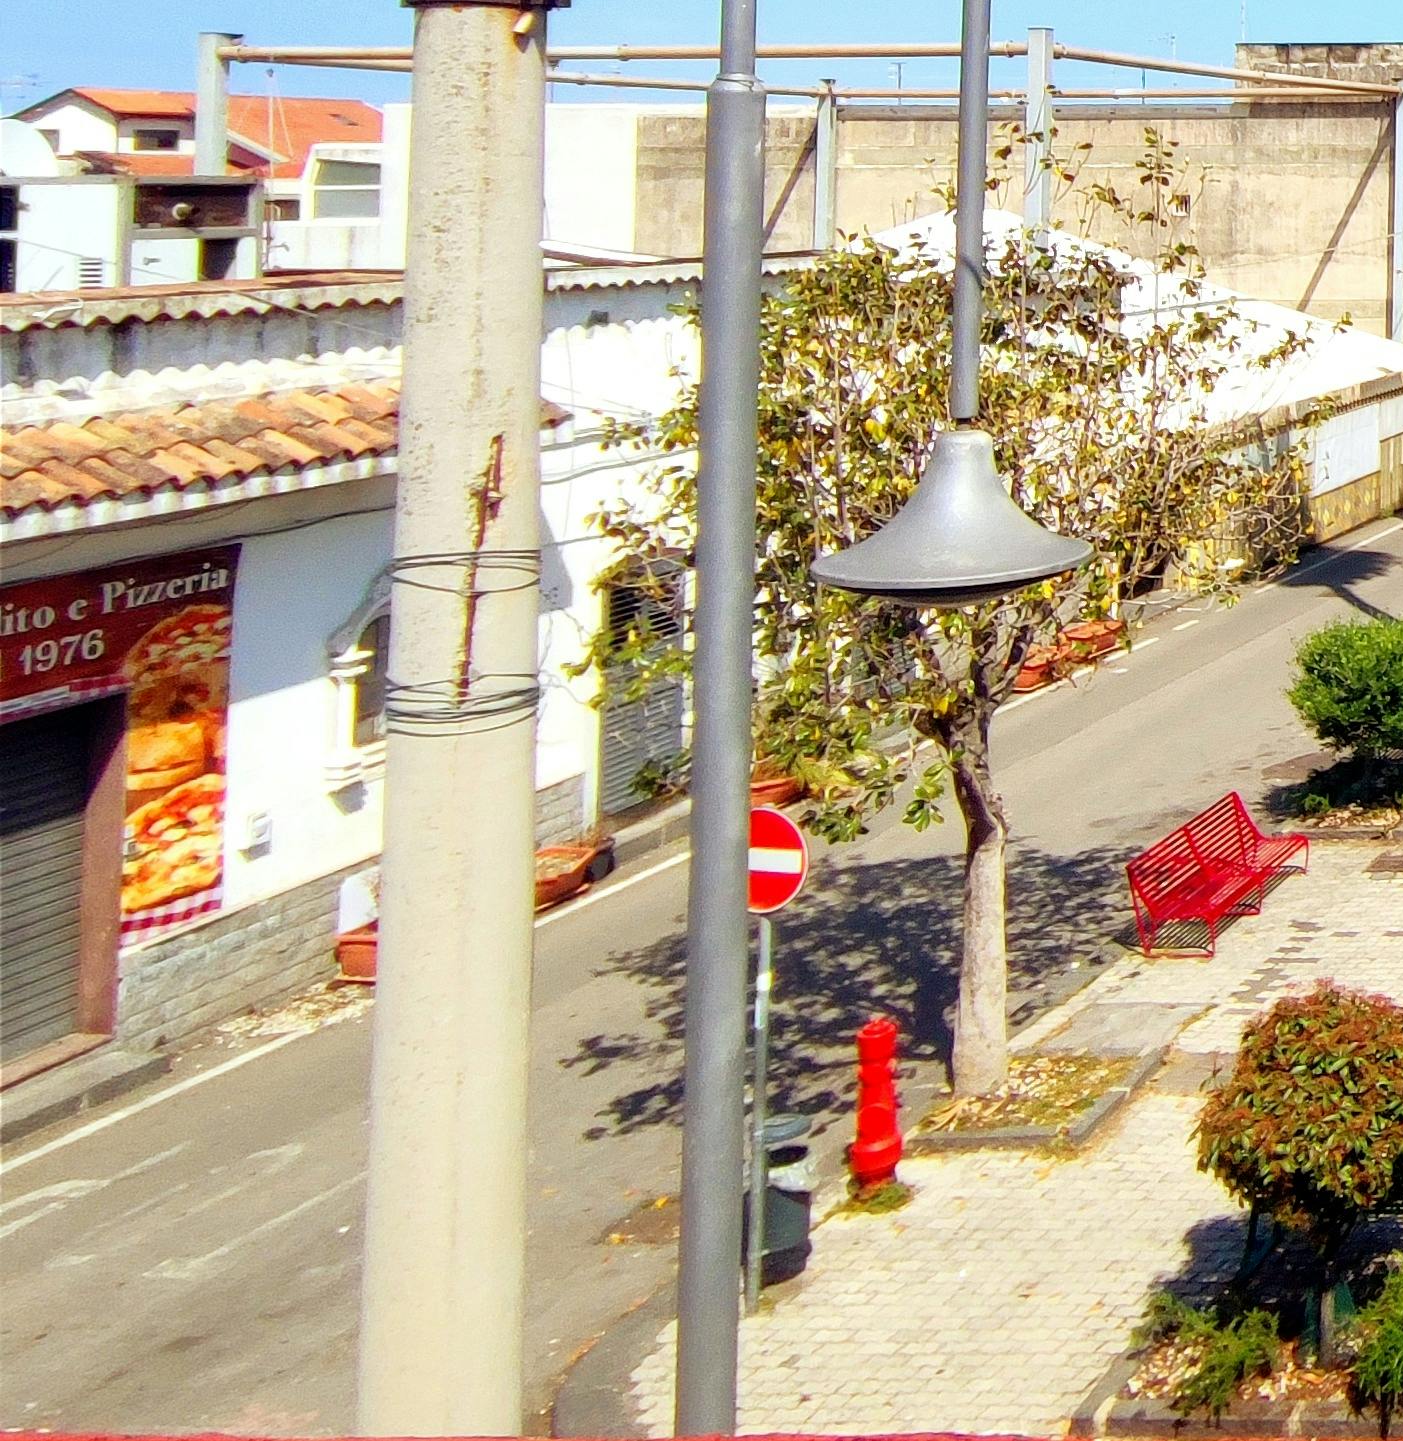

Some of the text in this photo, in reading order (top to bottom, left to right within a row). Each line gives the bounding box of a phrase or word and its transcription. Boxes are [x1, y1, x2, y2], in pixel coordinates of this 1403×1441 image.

[0, 562, 230, 637] ito e Pizzeria
[19, 629, 105, 675] 1976
